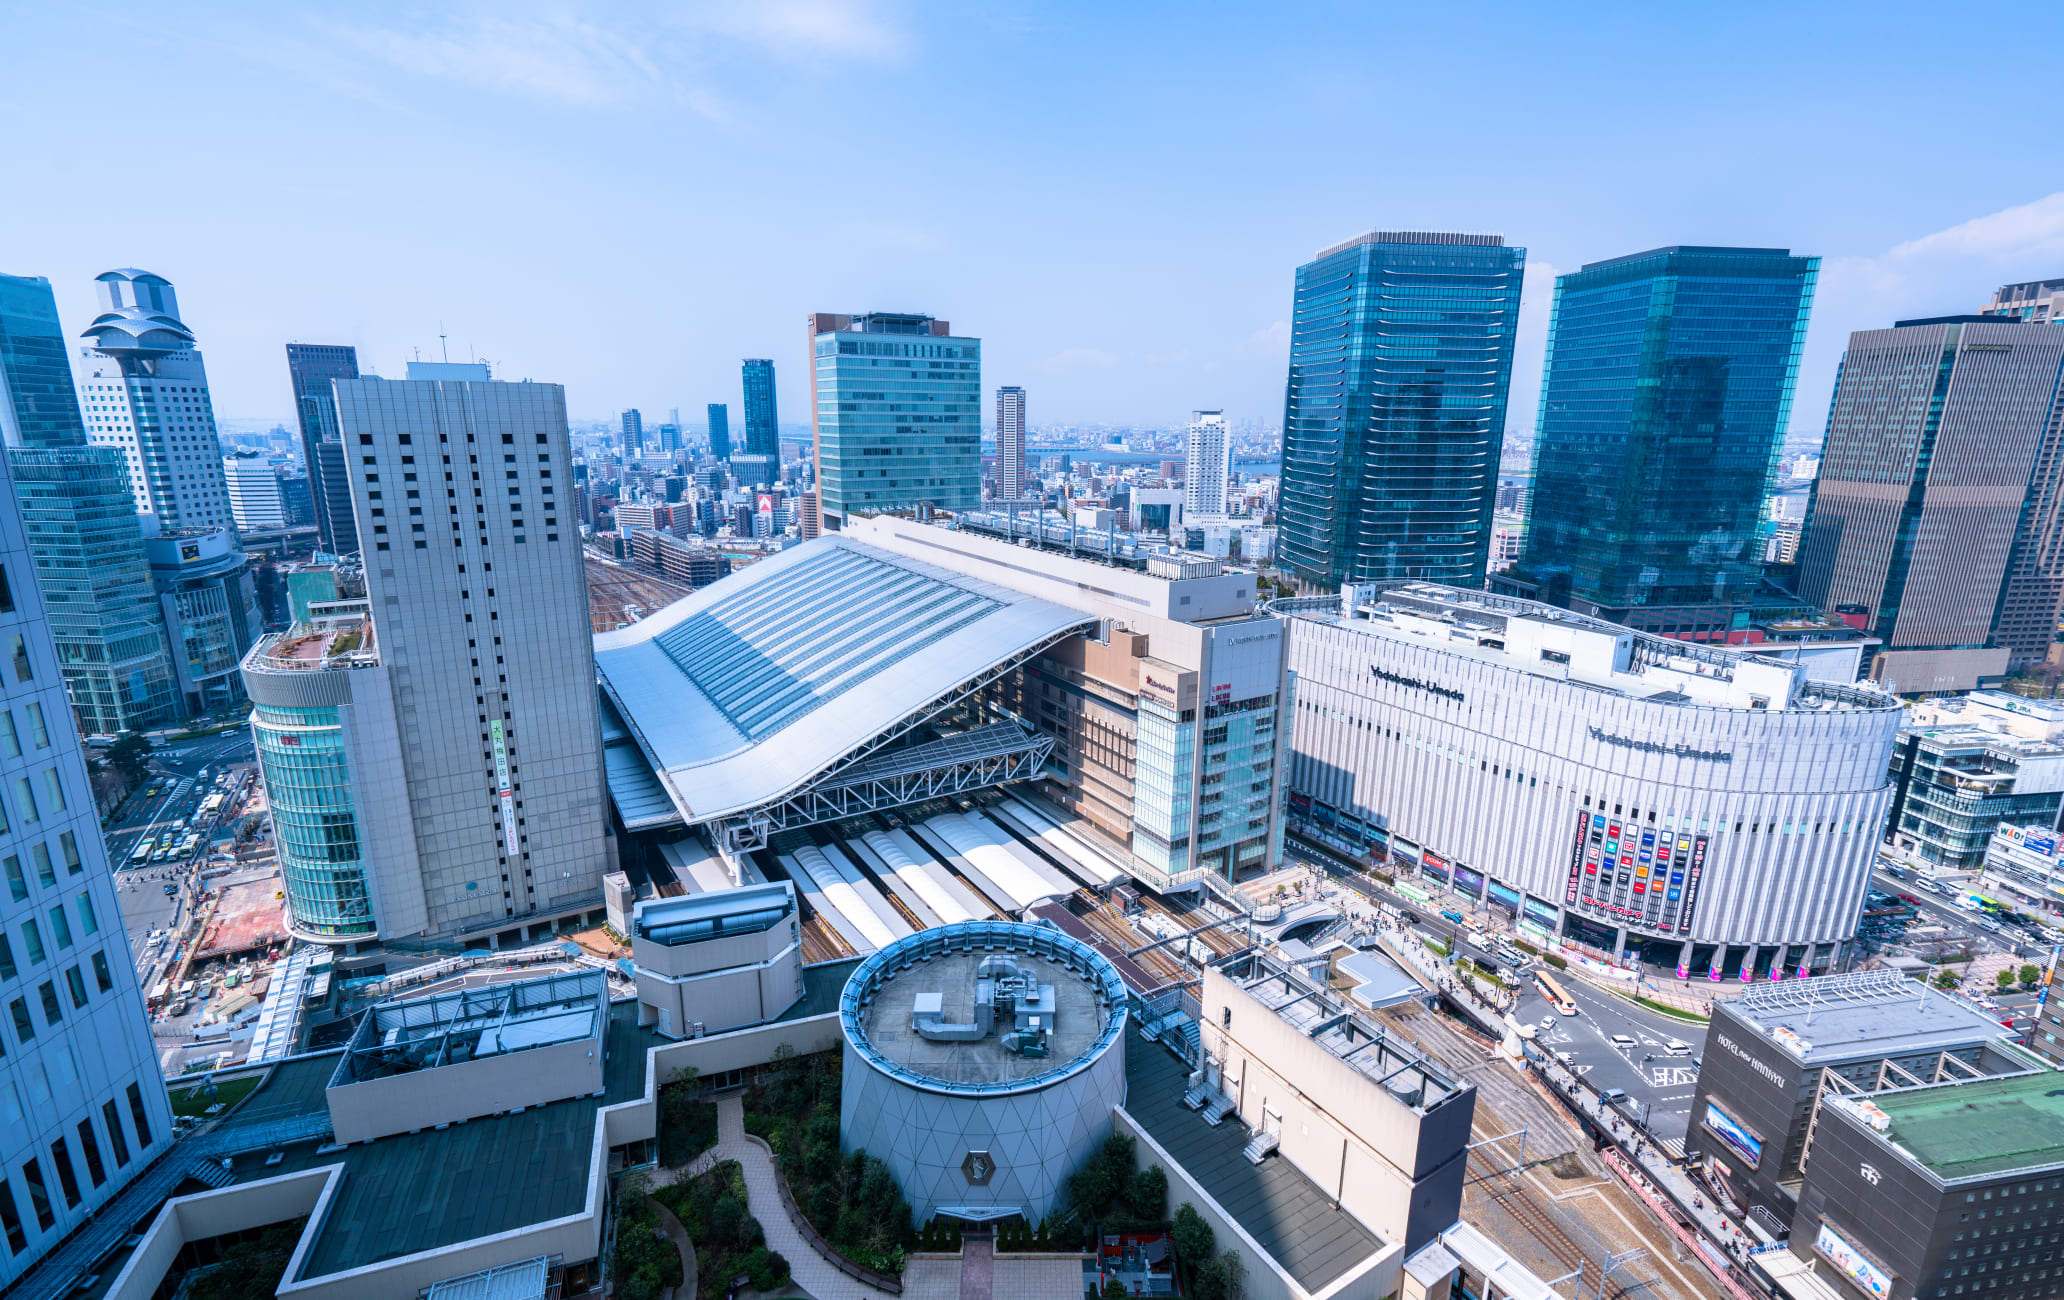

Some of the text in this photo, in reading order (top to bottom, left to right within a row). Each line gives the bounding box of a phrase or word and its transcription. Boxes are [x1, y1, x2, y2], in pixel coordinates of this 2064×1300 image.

[1371, 665, 1464, 702] Yodobashi-Umeda
[1588, 725, 1731, 764] Yodobashi-Umeda
[1583, 896, 1642, 918] ヨドバシカメラ
[1717, 1033, 1785, 1088] HOTEL new HANKYU
